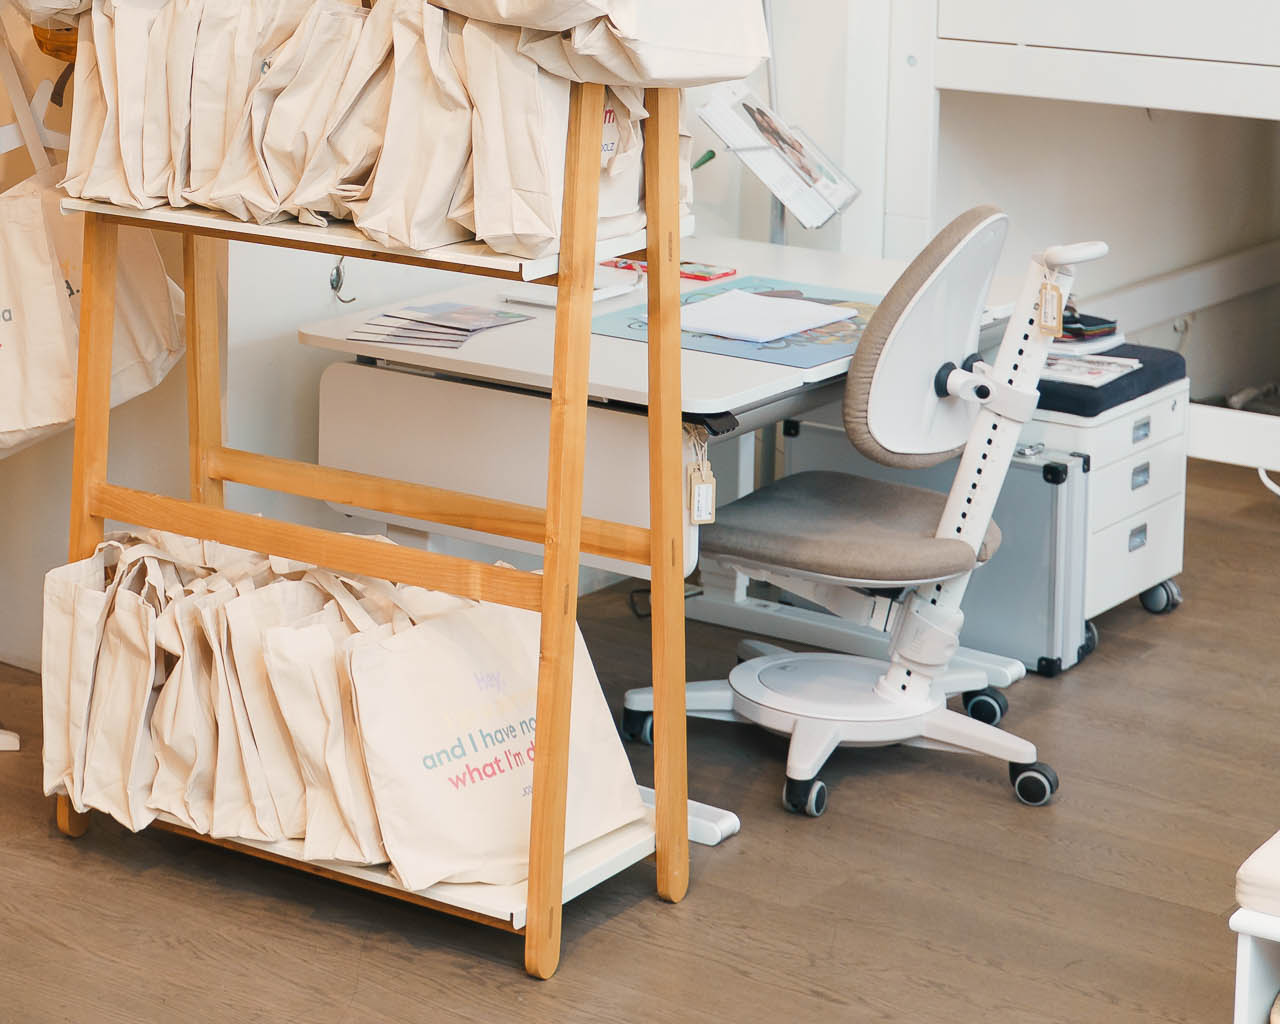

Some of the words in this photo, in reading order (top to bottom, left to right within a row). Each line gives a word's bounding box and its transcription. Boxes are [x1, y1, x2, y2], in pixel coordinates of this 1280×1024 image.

[422, 736, 468, 771] and
[467, 732, 479, 754] I
[478, 728, 518, 750] have
[447, 755, 505, 791] what
[504, 748, 526, 770] I'm
